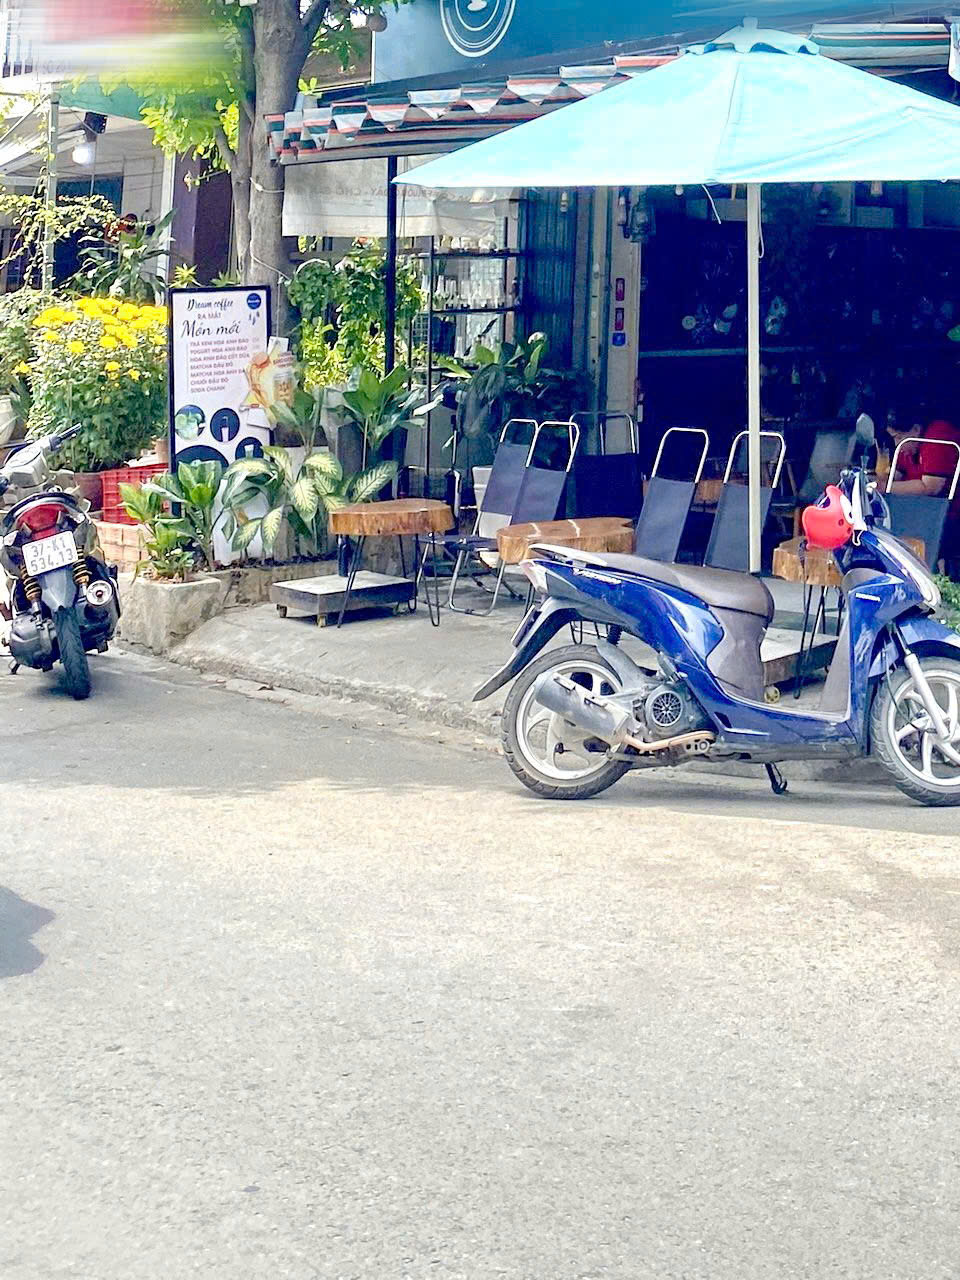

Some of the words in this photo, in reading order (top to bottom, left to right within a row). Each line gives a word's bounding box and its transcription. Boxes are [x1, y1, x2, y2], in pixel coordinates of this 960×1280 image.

[187, 299, 212, 311] Dream
[31, 537, 66, 558] 37-K1
[30, 548, 73, 572] 534.13
